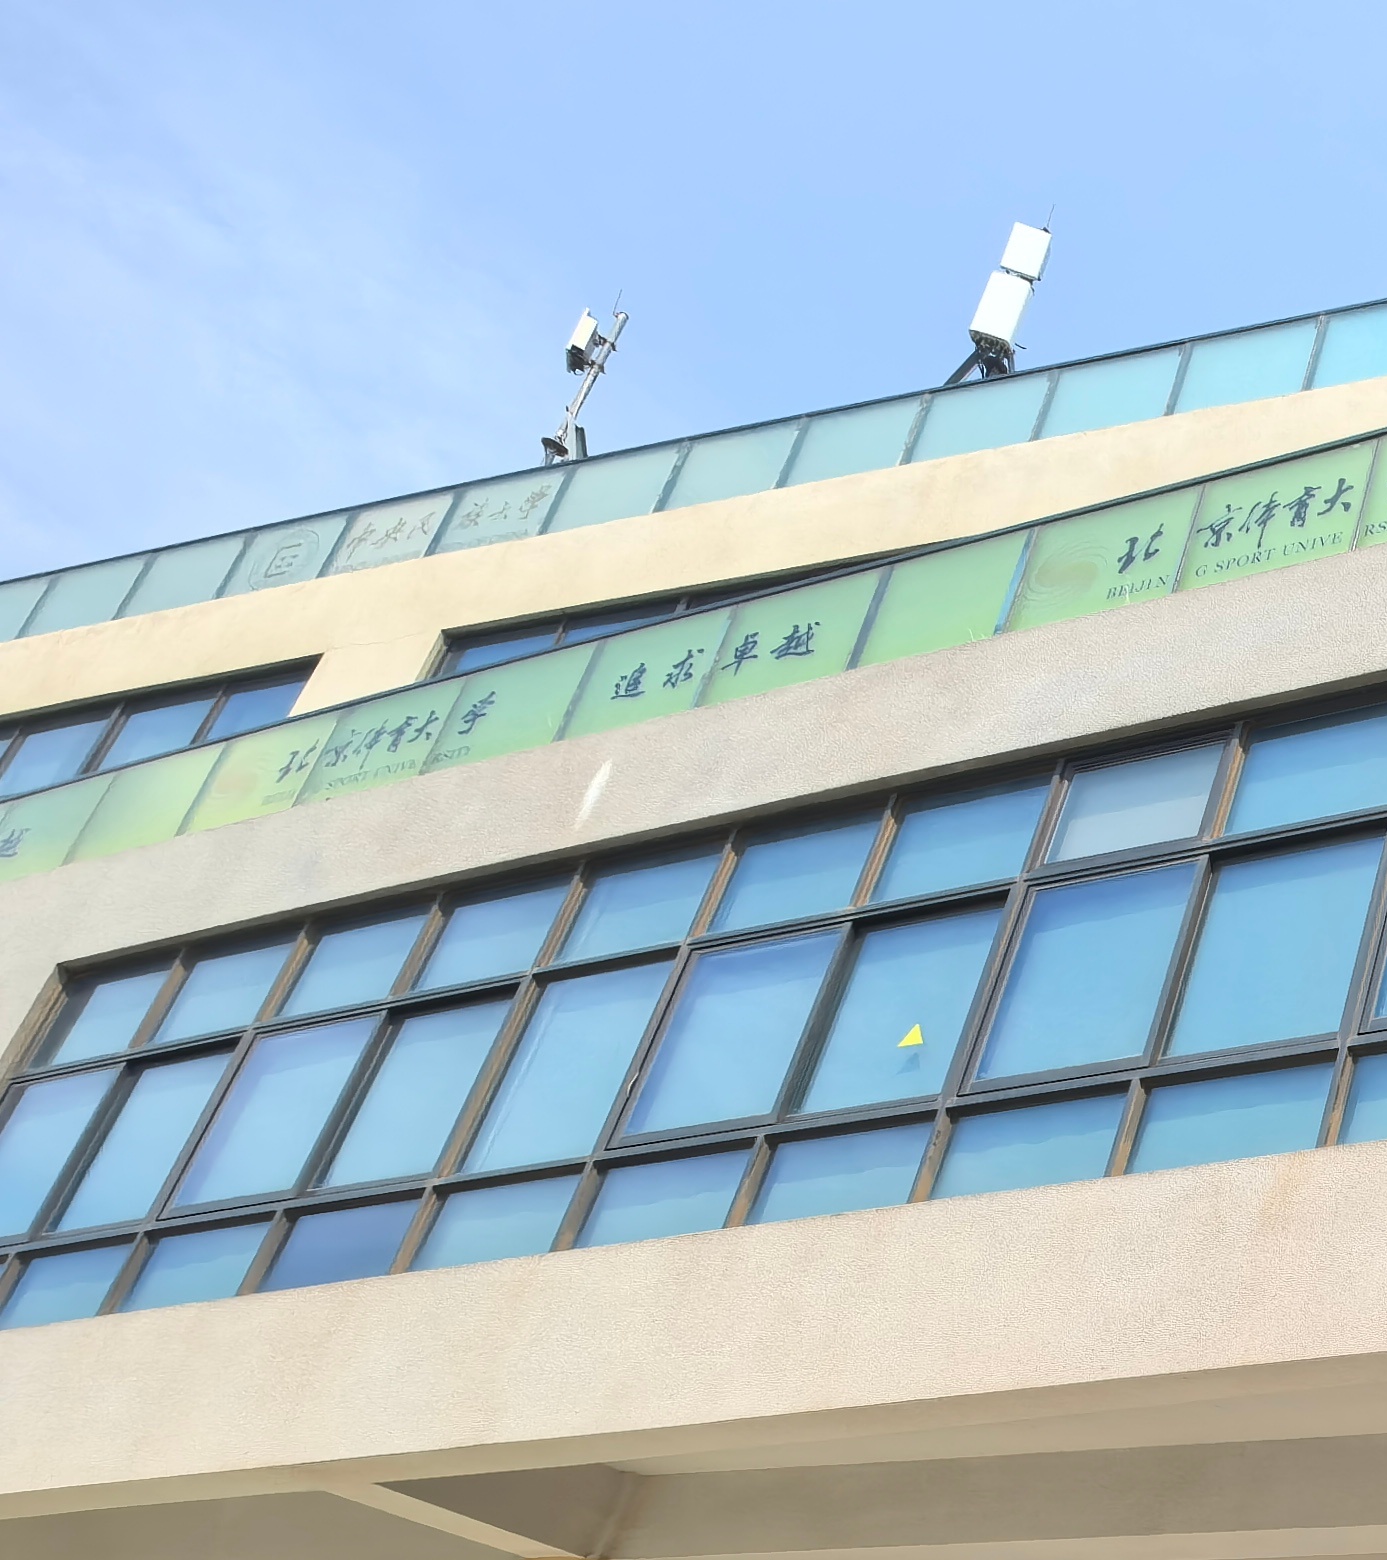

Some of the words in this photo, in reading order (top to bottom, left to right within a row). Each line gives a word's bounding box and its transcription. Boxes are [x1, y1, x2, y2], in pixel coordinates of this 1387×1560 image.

[1213, 548, 1276, 574] SPORT
[611, 621, 821, 700] 追求卓越
